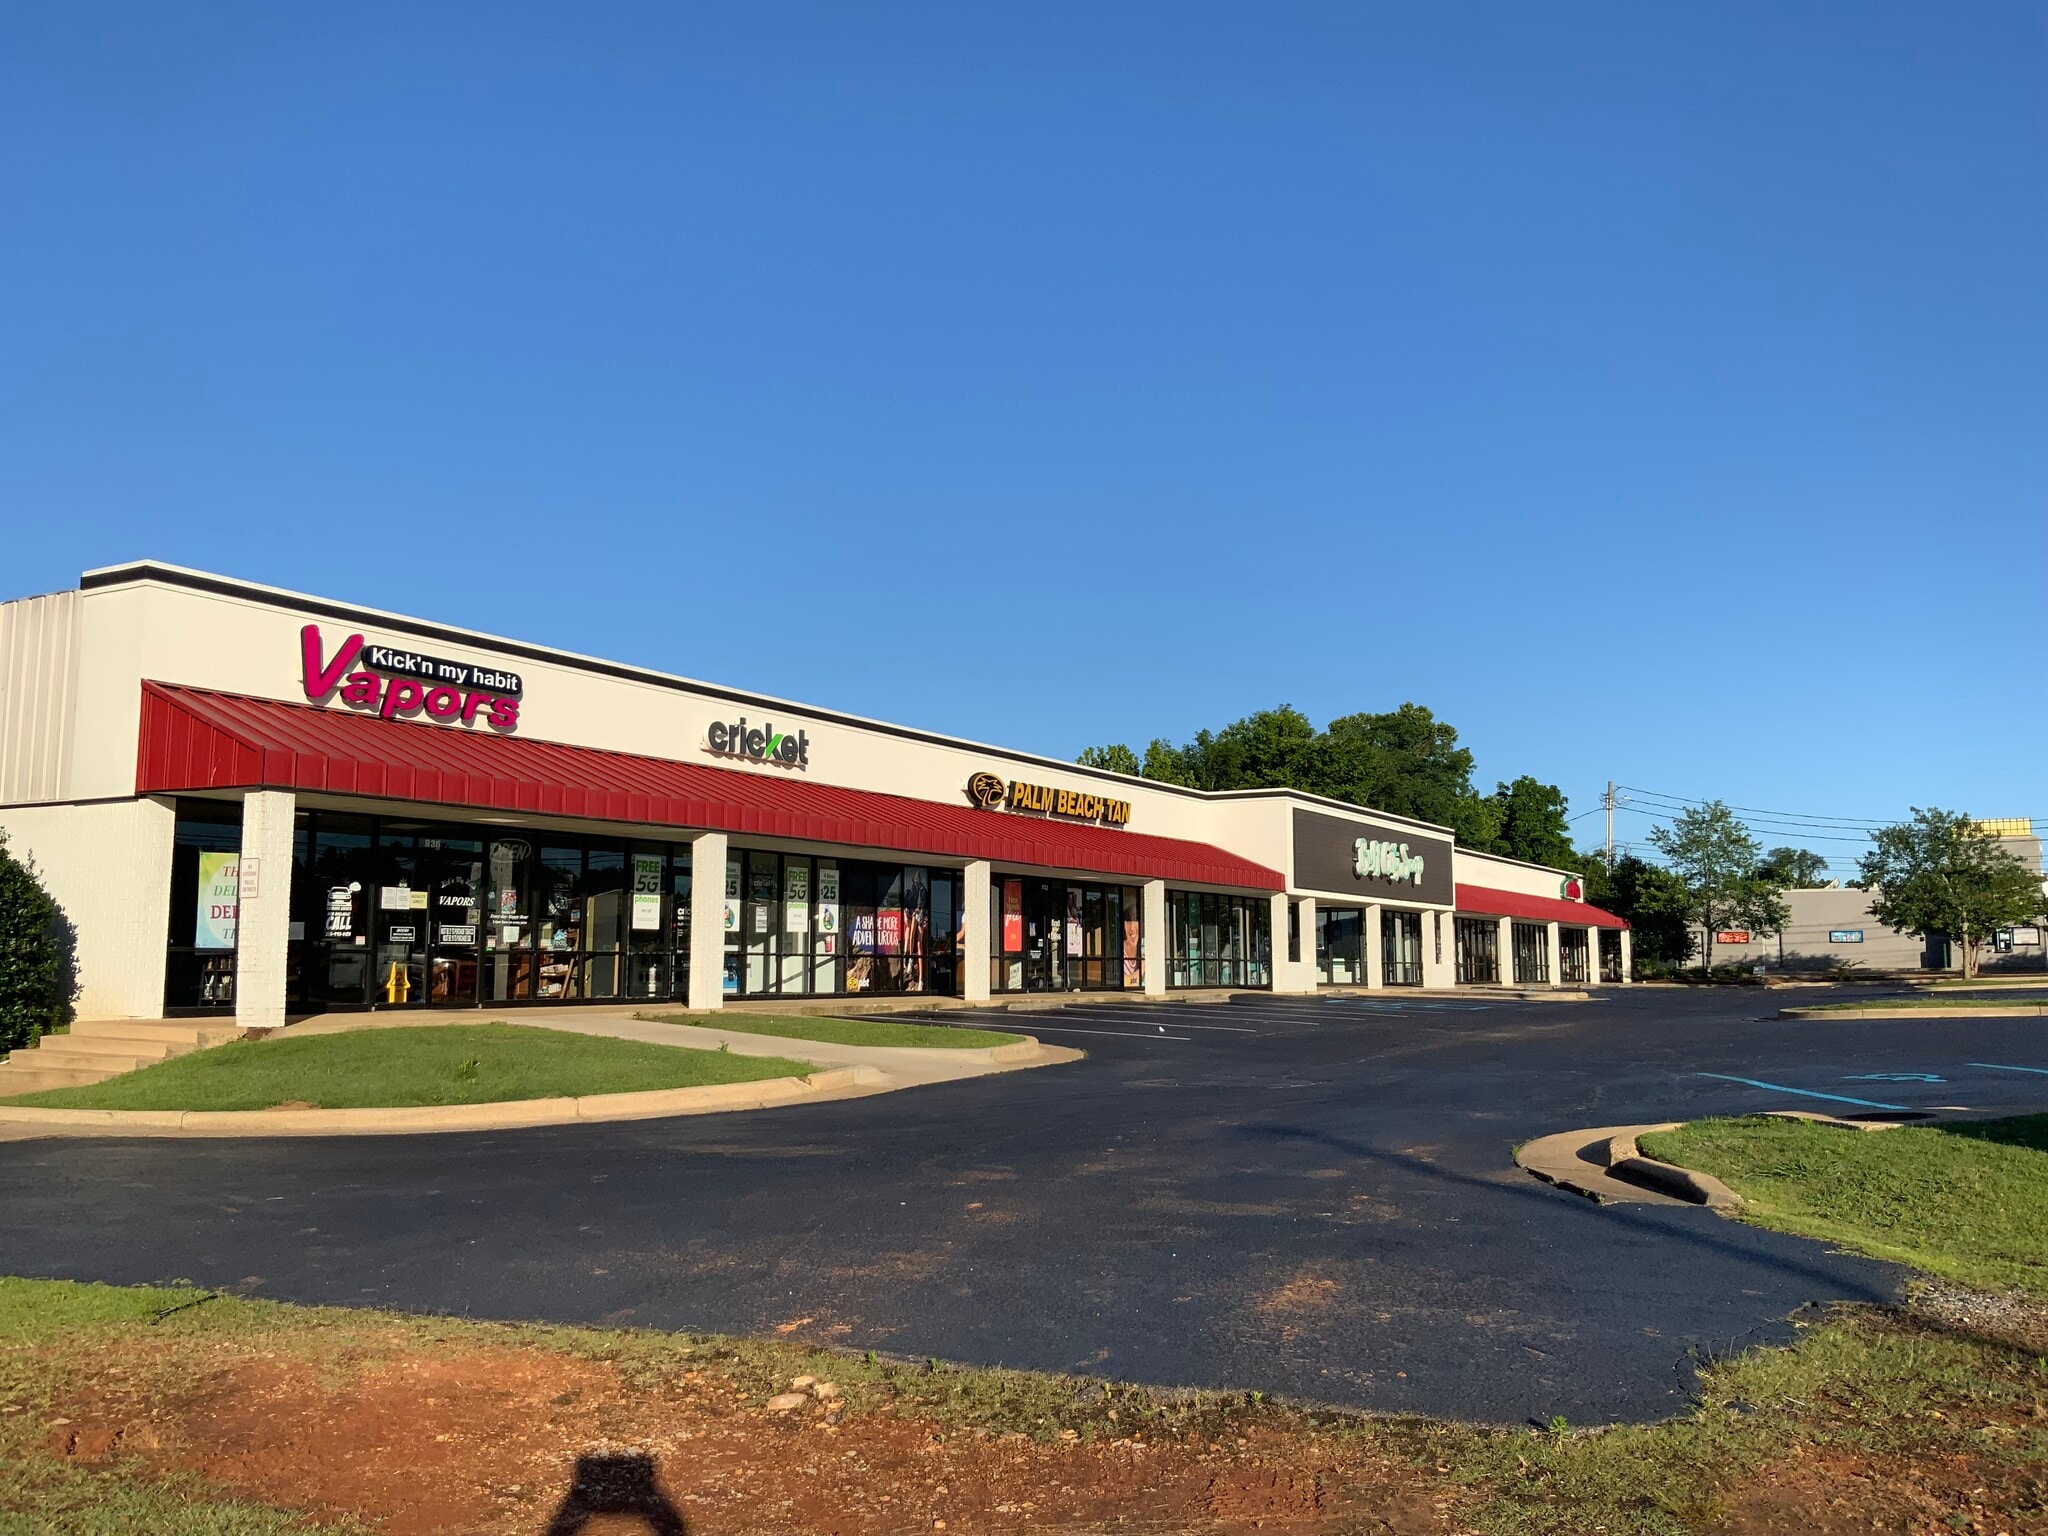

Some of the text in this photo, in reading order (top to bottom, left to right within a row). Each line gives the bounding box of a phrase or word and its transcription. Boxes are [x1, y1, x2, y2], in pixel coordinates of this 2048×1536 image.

[300, 623, 520, 727] Vapors
[371, 647, 518, 691] Kick'n my habit
[707, 717, 810, 765] cricket
[1012, 782, 1132, 824] PALM BEACH TAN
[222, 866, 240, 878] TH
[635, 859, 660, 874] FREE
[635, 874, 660, 892] 5G
[788, 870, 808, 882] FREE
[213, 885, 238, 897] DEL
[788, 883, 808, 900] 5G
[438, 896, 476, 907] VAPORS
[634, 895, 659, 905] phones
[325, 916, 352, 931] CALL
[855, 915, 861, 930] A
[883, 916, 899, 930] MORE
